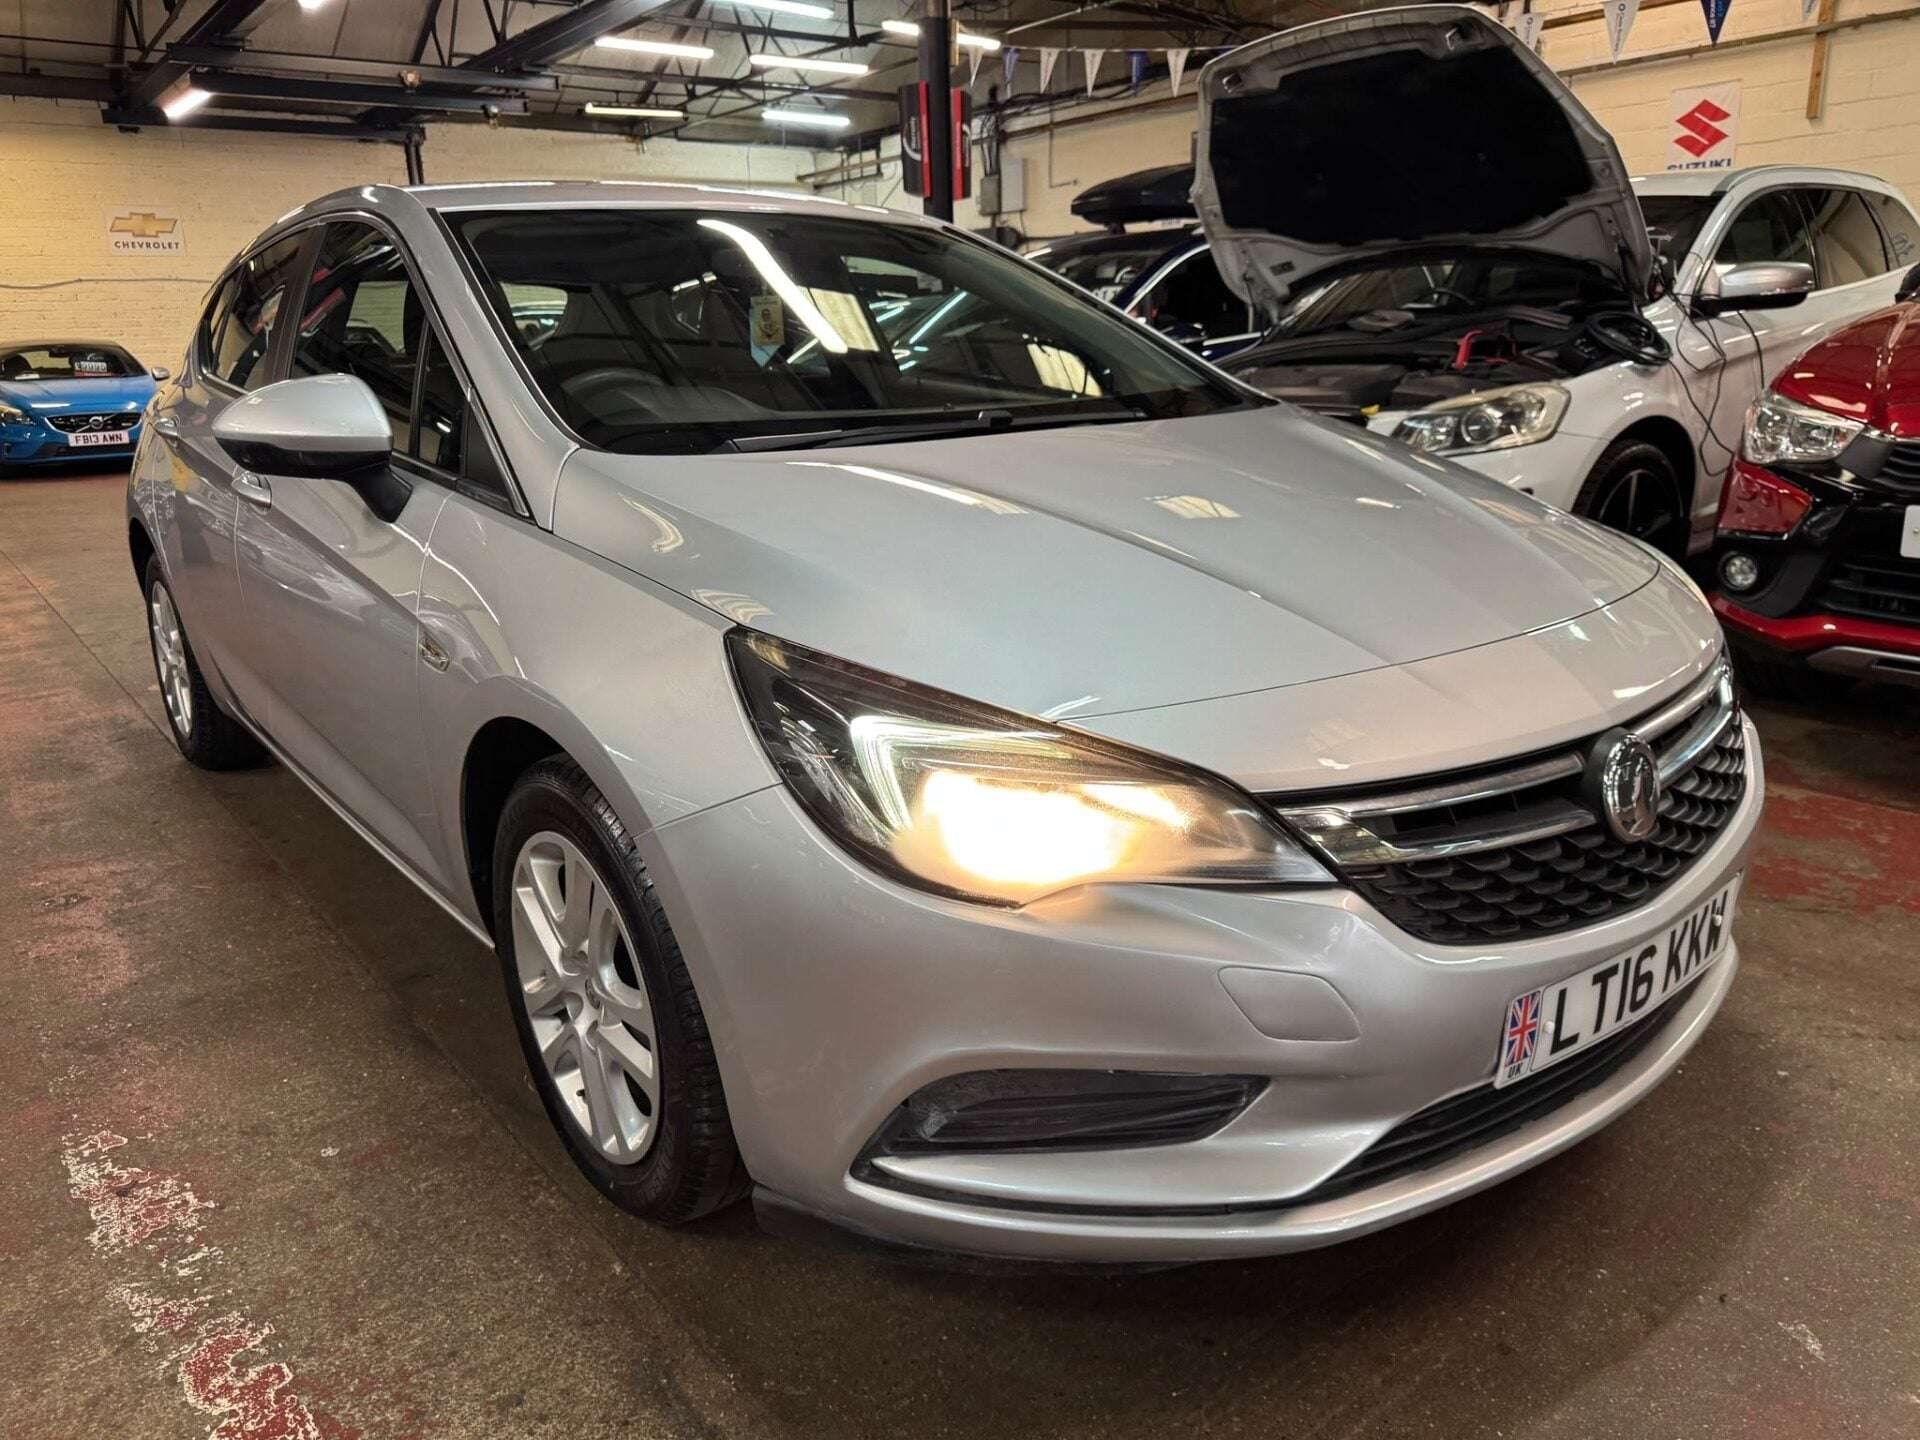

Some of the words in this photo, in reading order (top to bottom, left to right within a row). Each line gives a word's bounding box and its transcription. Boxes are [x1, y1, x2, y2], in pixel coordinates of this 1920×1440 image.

[114, 240, 180, 249] CHEVROLET
[75, 434, 100, 445] FB13
[1550, 943, 1658, 1055] LT16
